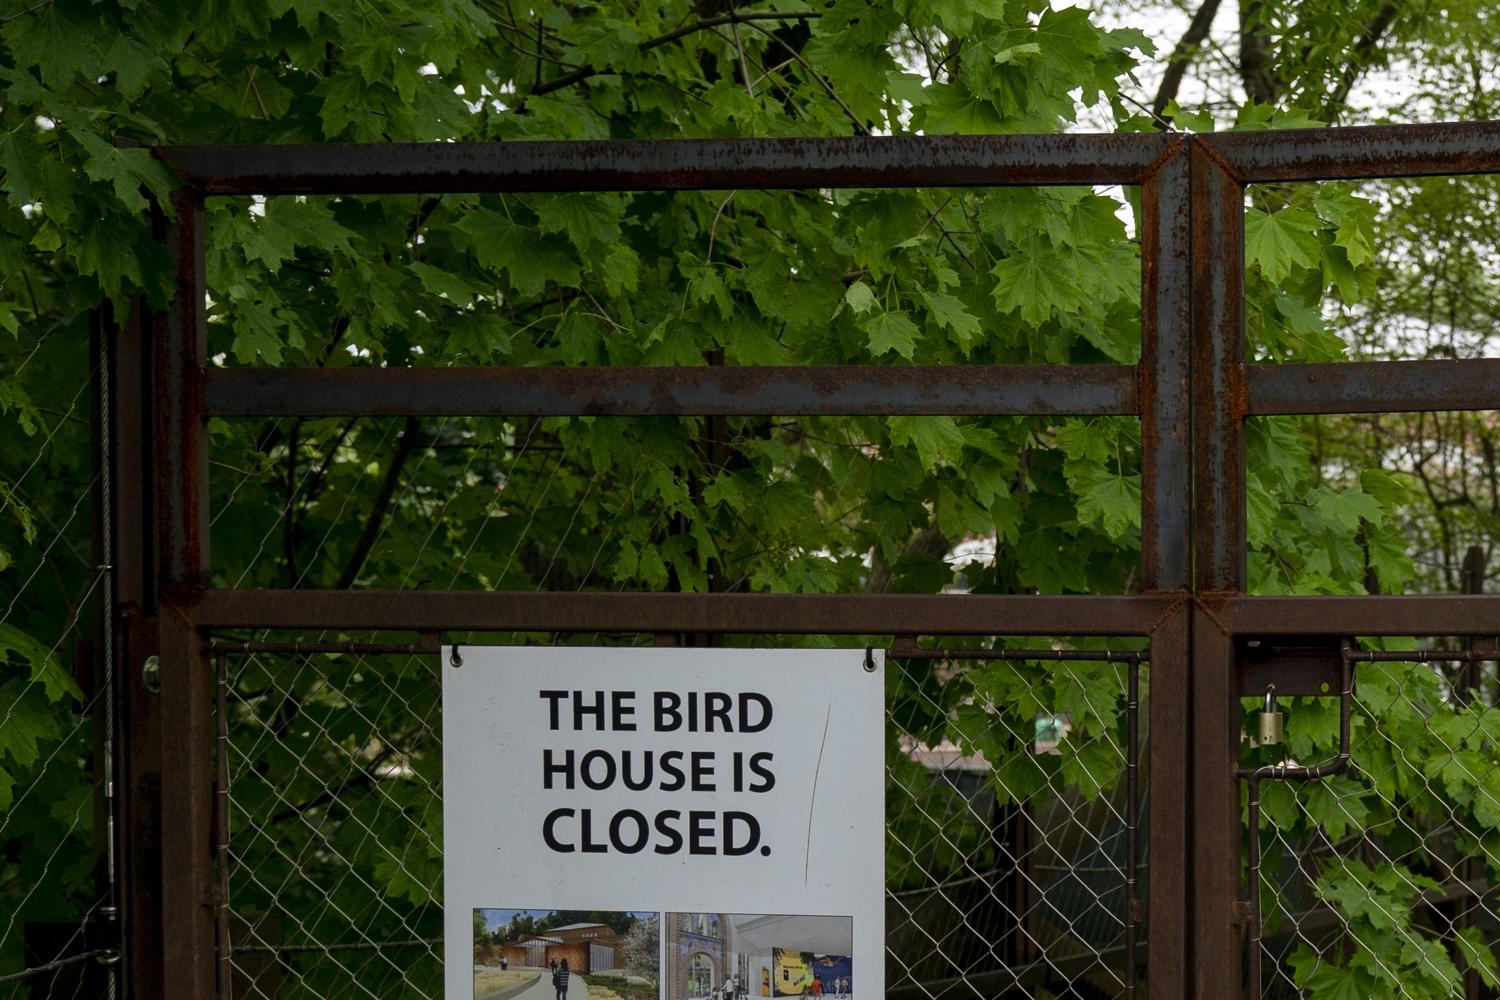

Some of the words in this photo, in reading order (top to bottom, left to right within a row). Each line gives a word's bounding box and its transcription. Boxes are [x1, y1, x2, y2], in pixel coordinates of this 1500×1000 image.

[539, 689, 637, 732] THE
[653, 691, 774, 734] BIRD
[542, 748, 717, 793] HOUSE
[733, 751, 776, 794] IS
[542, 807, 772, 857] CLOSED.
